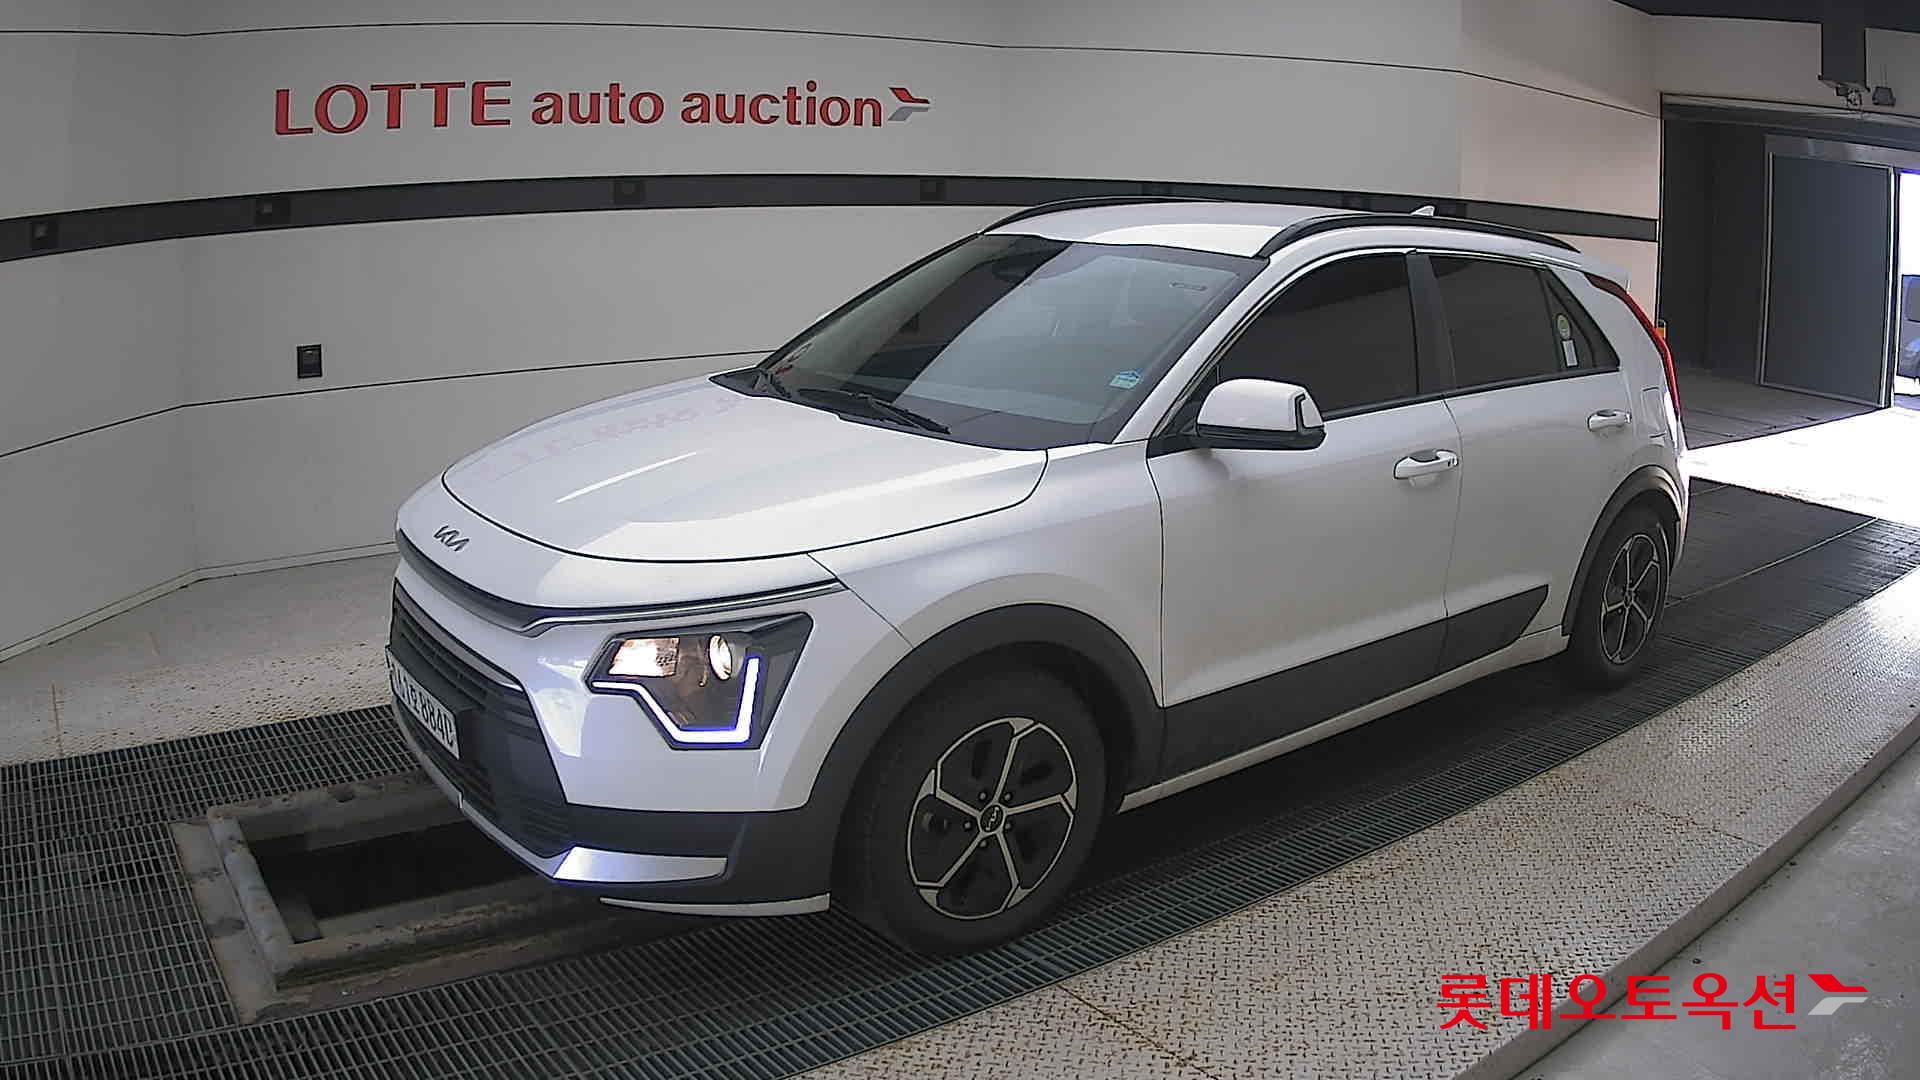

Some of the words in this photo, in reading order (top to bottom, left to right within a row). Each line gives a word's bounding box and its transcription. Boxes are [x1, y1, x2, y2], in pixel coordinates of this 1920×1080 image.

[274, 82, 510, 135] LOTTE
[533, 84, 664, 125] auto
[681, 81, 883, 127] auction
